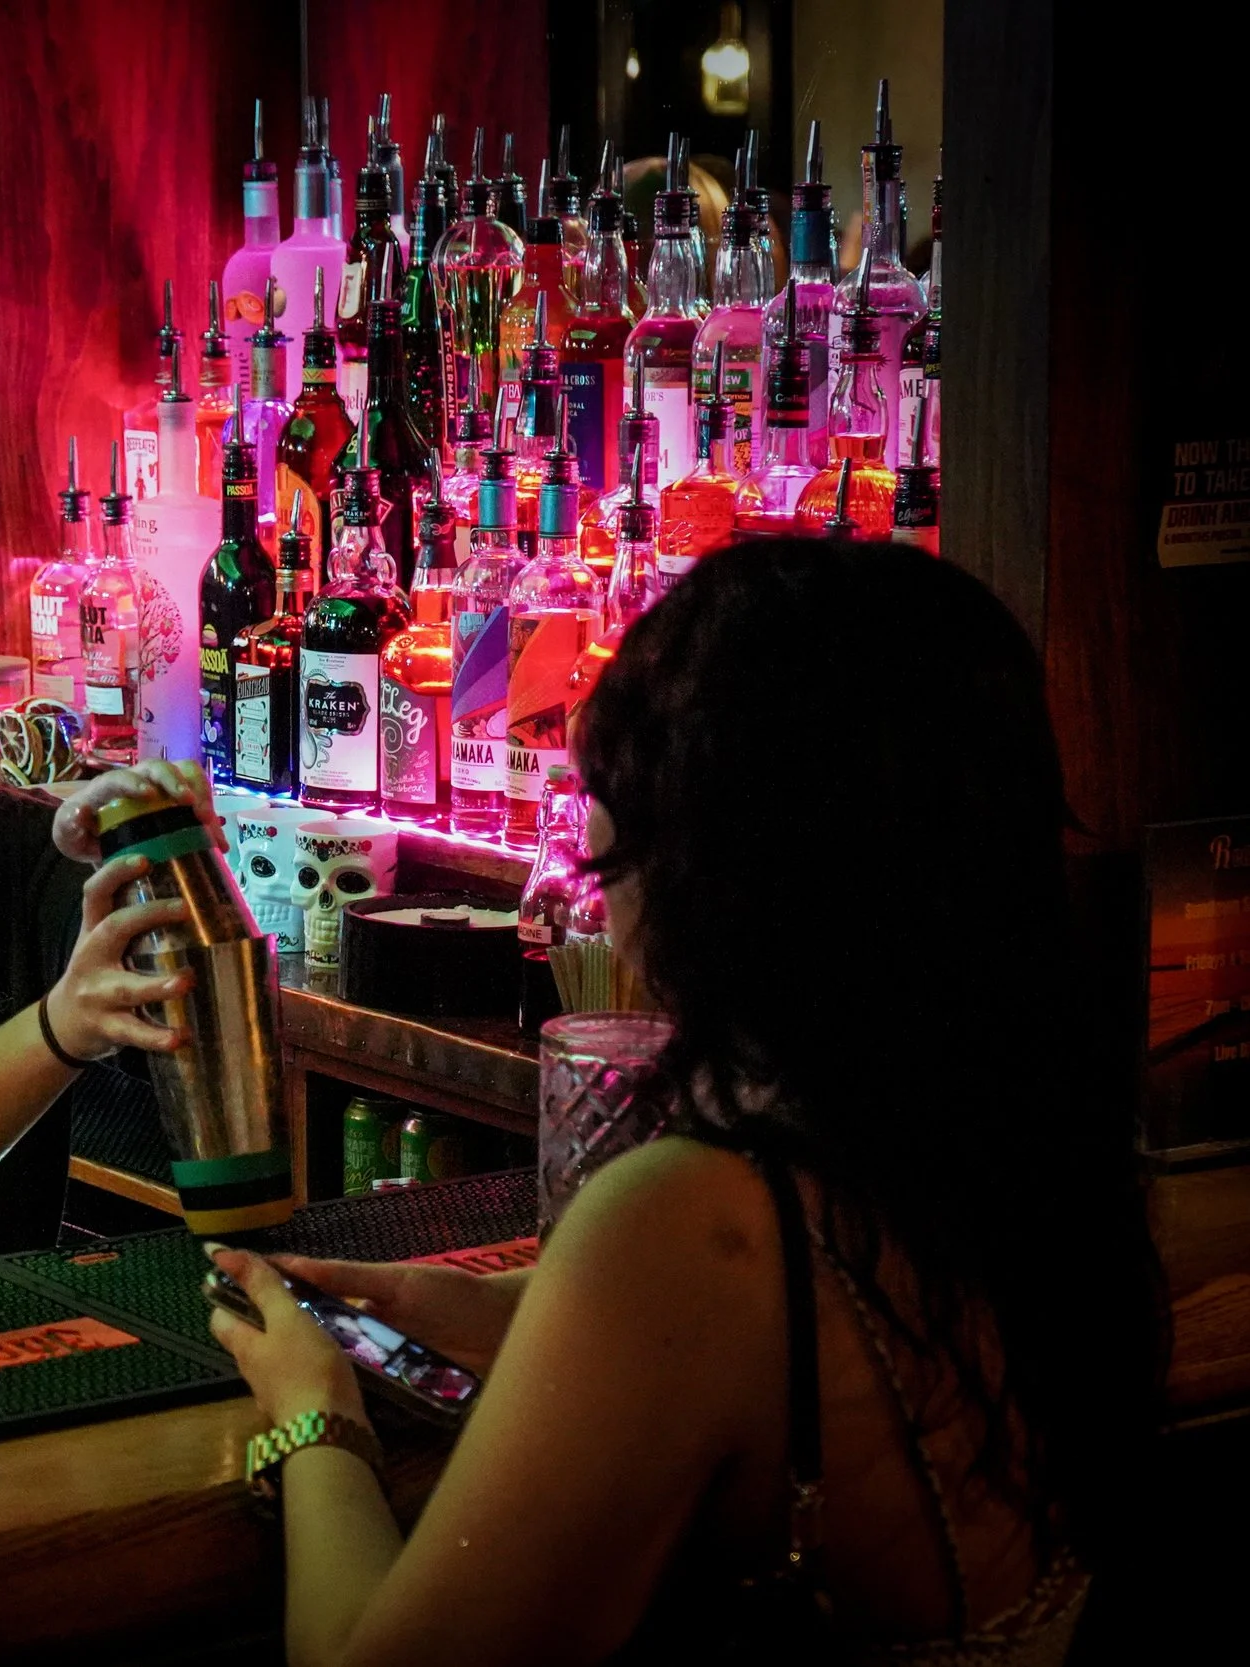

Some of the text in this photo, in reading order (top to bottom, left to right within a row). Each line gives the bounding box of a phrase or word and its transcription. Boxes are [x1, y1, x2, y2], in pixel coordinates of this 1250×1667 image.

[443, 330, 456, 419] ST-GERMAIN
[570, 374, 596, 386] CROSS
[1174, 440, 1219, 466] NOW
[1174, 467, 1250, 496] TO TAKE
[1168, 503, 1218, 528] DRINK
[309, 698, 357, 711] KRAKEN
